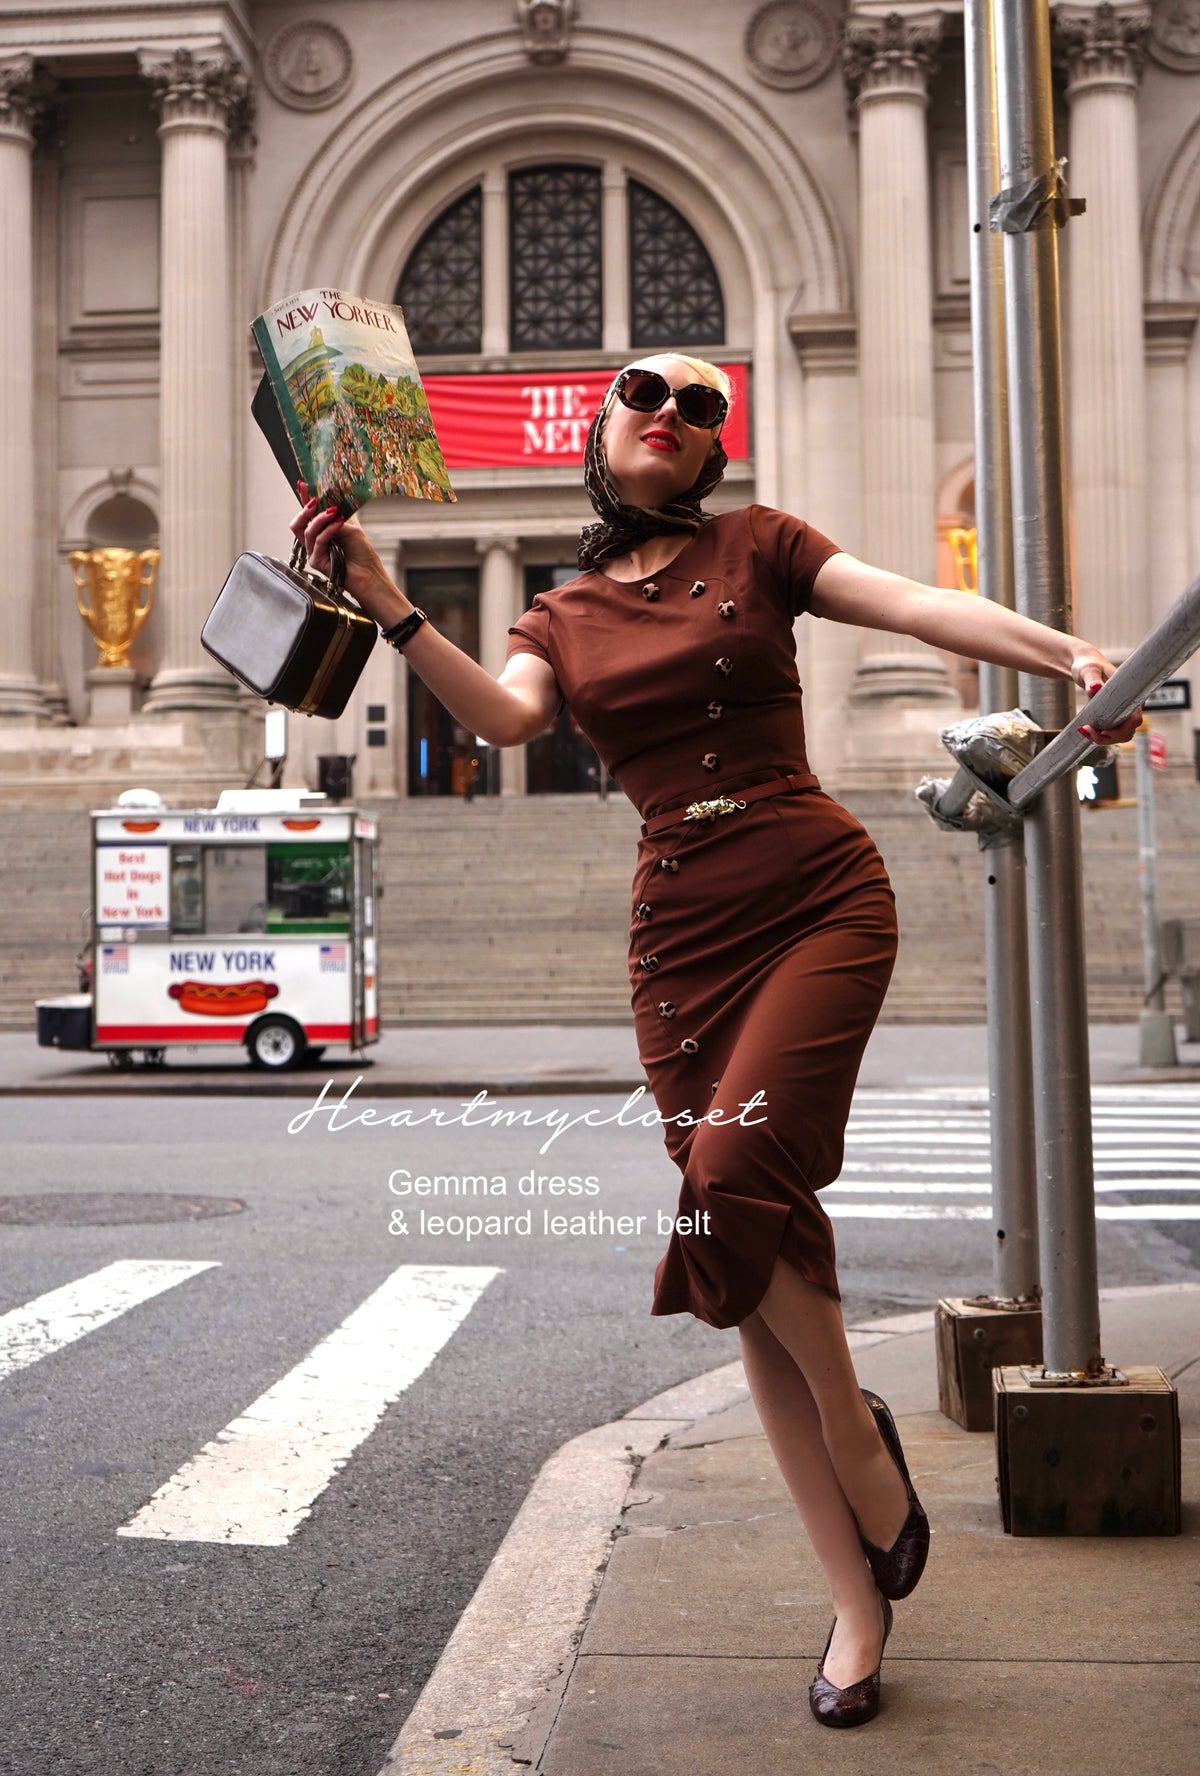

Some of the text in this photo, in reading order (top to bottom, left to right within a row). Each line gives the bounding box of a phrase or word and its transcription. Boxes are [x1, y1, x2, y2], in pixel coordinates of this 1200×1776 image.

[320, 290, 342, 300] THE
[276, 301, 398, 338] NEW YORKER
[521, 385, 588, 418] THE
[522, 419, 590, 454] MET
[183, 816, 259, 832] NEW YORK
[104, 870, 161, 884] Hot Dogs
[103, 905, 162, 918] New York
[170, 951, 275, 972] NEW YORK
